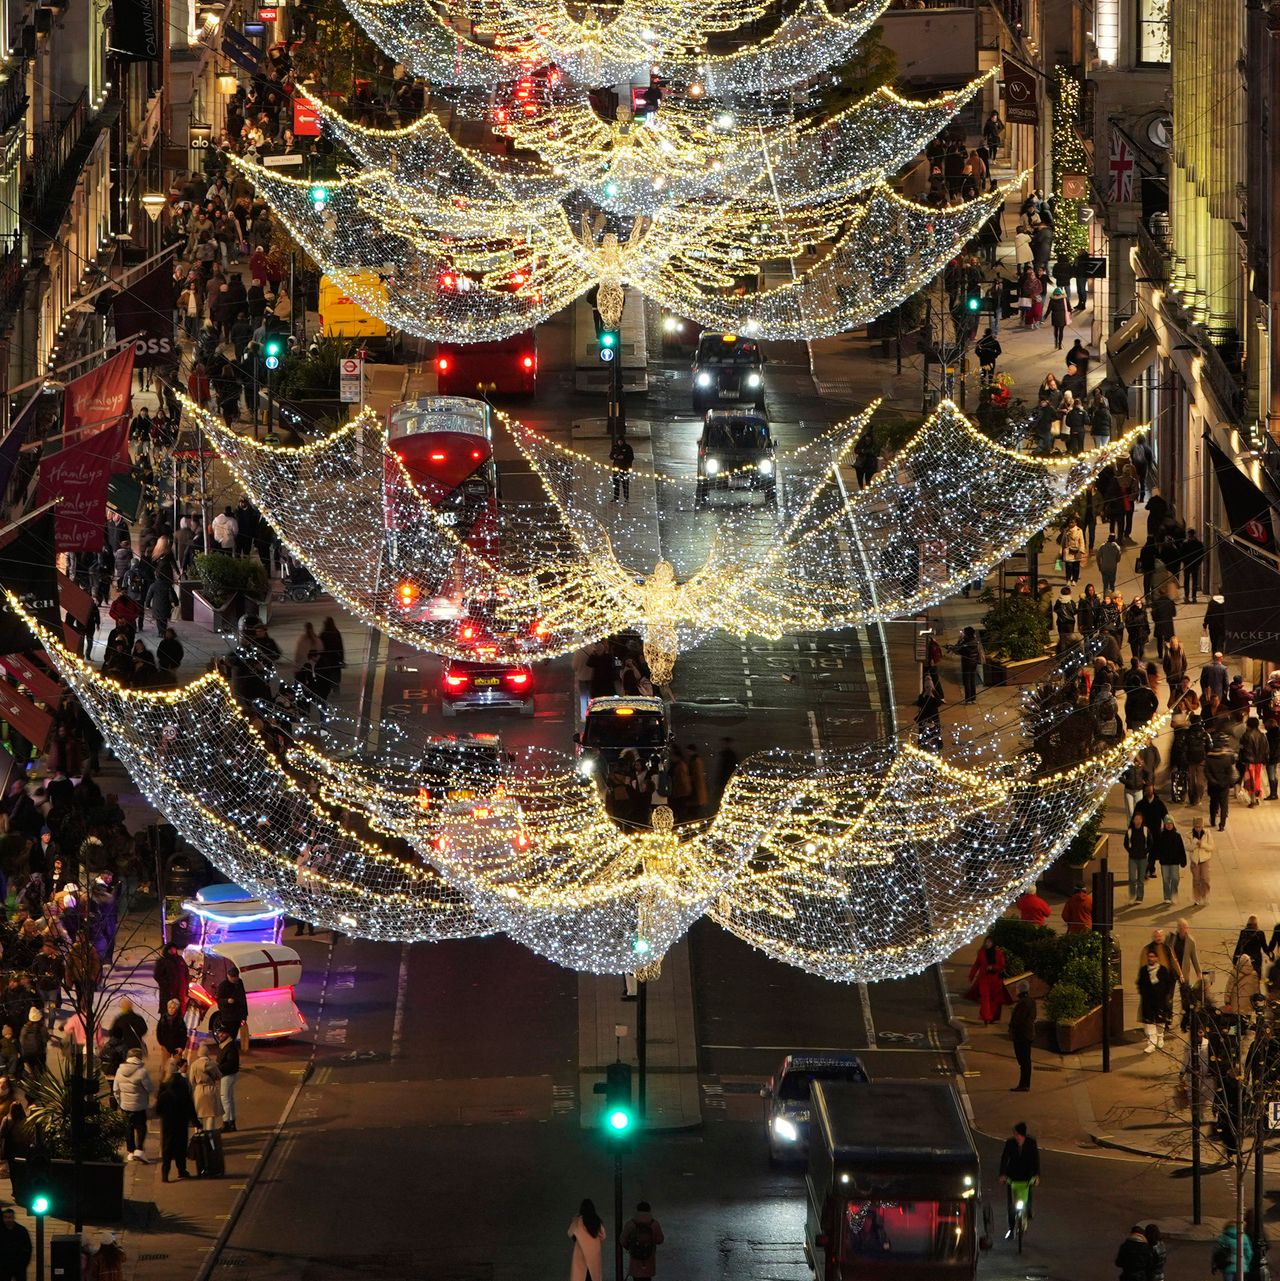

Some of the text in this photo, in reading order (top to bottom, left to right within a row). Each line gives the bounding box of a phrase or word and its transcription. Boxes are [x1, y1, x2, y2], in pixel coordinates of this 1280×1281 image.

[191, 135, 209, 148] alo
[73, 392, 124, 413] Hamleys
[47, 461, 103, 486] Hamleys
[55, 523, 97, 548] amleys
[1225, 630, 1280, 641] HACKETT
